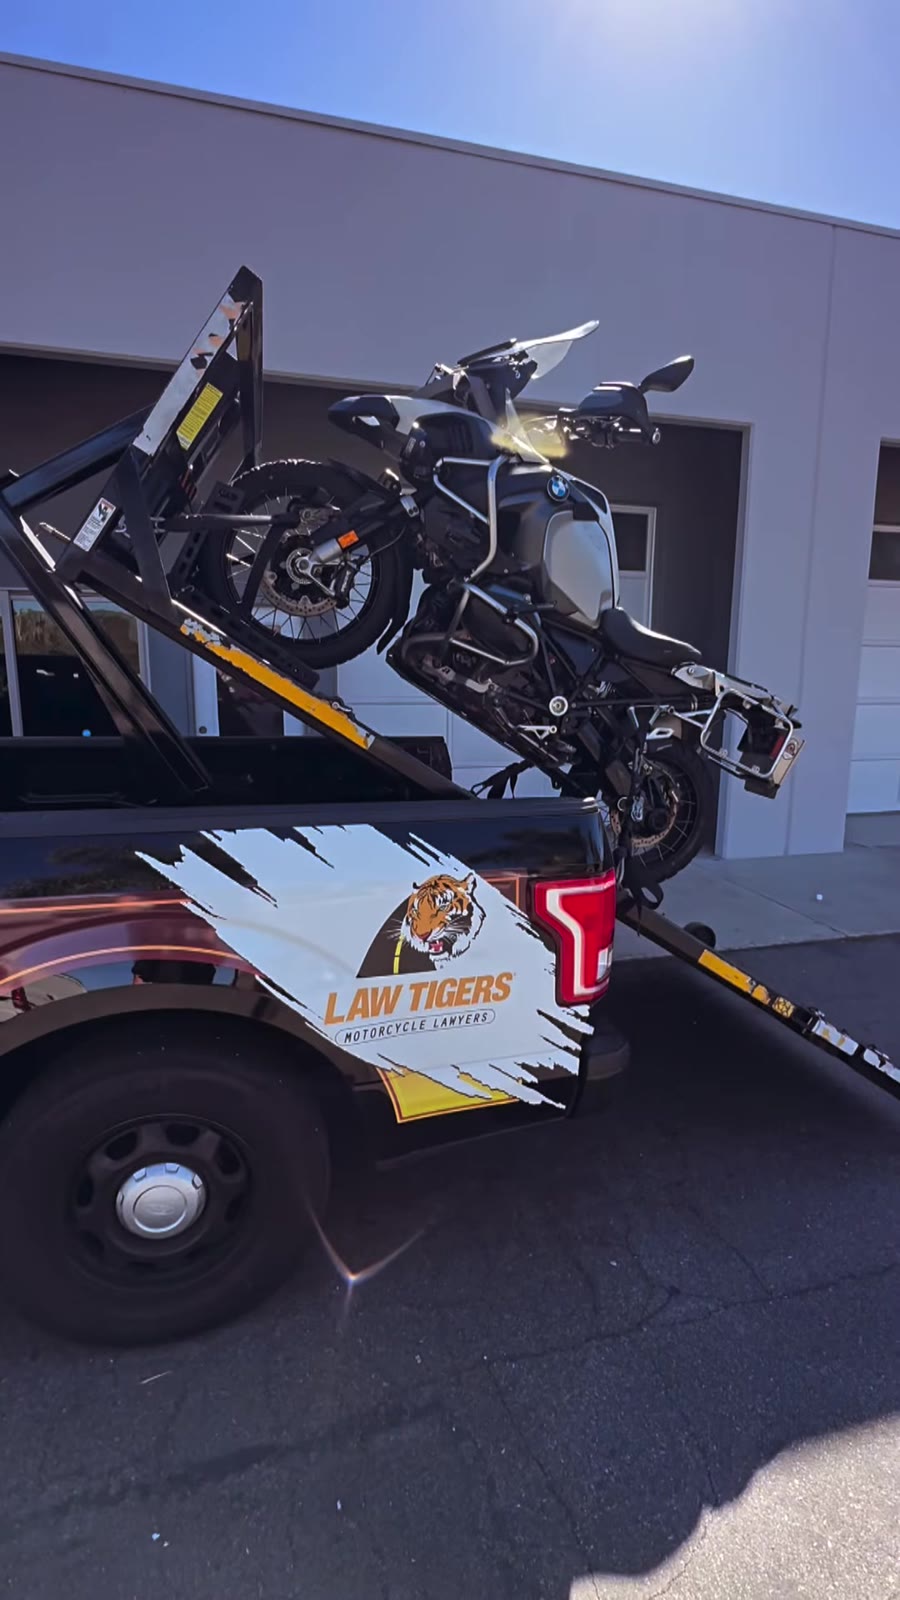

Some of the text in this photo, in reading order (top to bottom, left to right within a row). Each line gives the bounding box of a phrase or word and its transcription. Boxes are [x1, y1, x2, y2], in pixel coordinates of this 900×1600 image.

[324, 972, 513, 1025] LAW TIGERS
[344, 1012, 489, 1043] MOTORCYCLE LAWYERS
